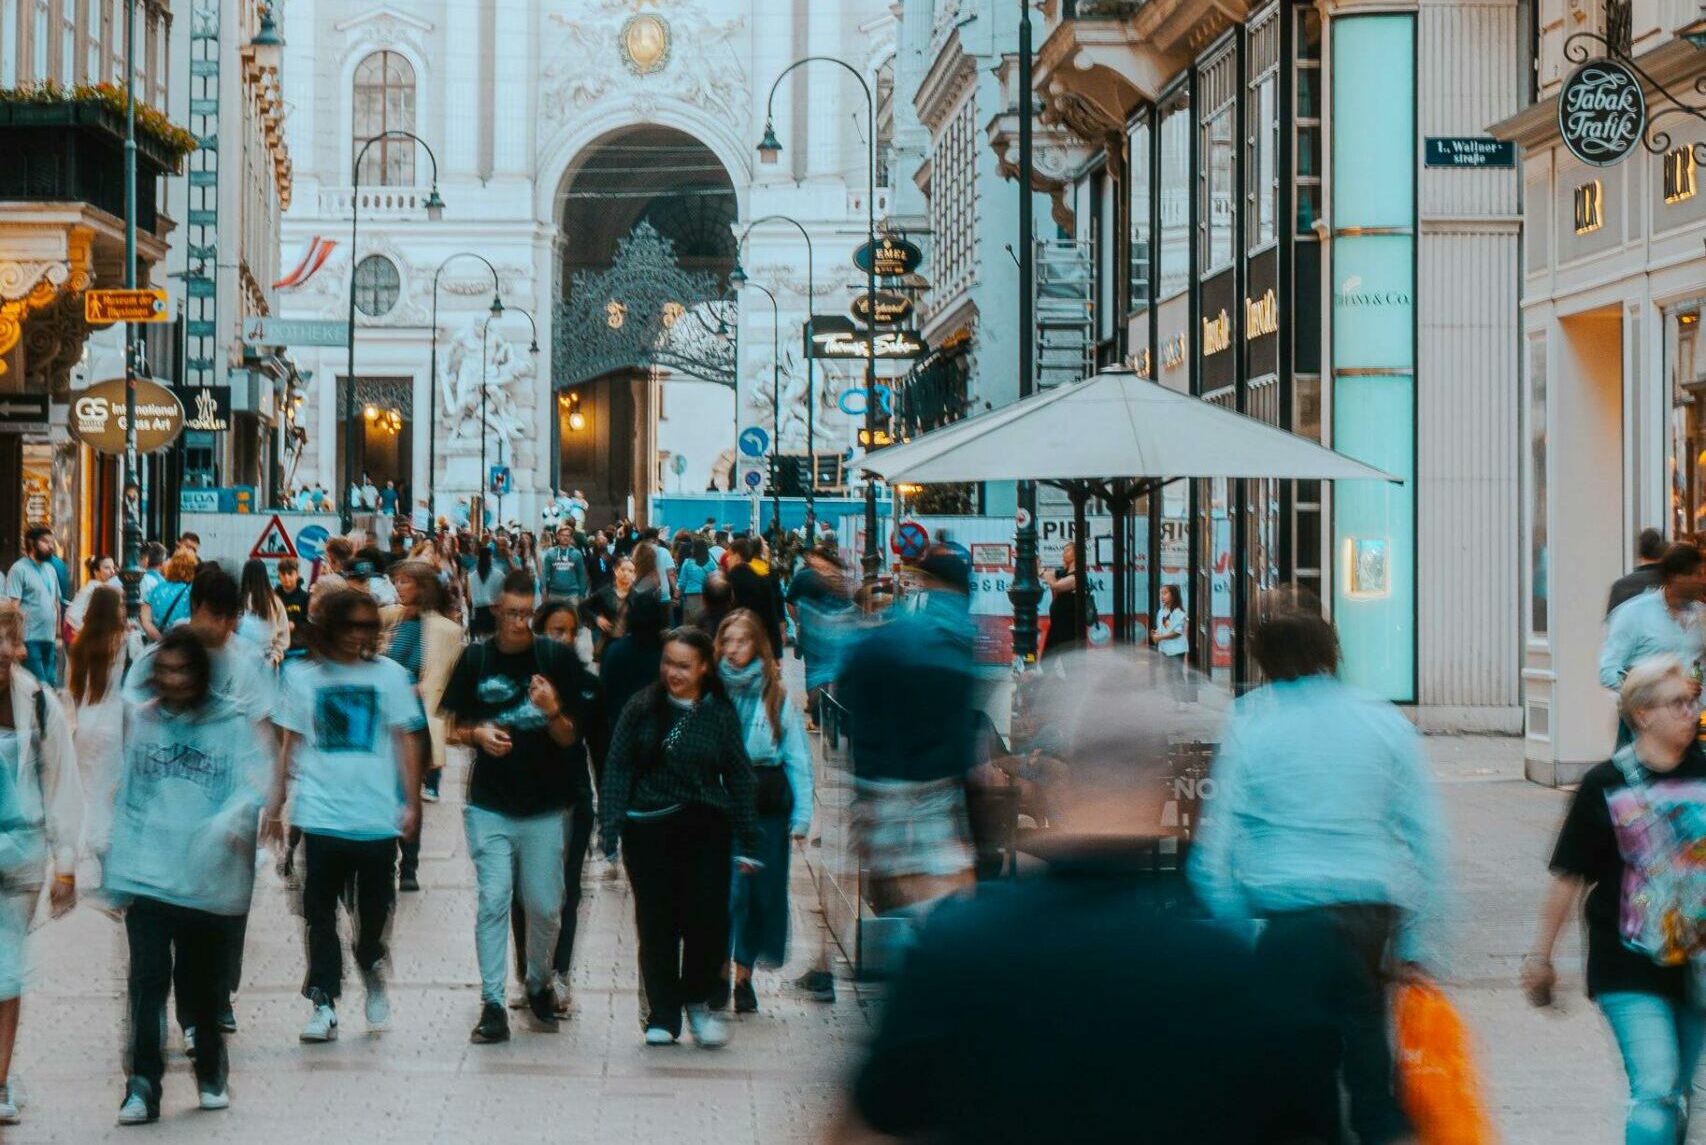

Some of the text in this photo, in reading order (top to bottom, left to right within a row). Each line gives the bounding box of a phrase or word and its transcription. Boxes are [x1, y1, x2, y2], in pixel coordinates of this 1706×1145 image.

[1566, 81, 1637, 112] Tabak
[1567, 111, 1637, 140] Trafik
[112, 402, 178, 417] Intnational
[152, 417, 171, 431] Art
